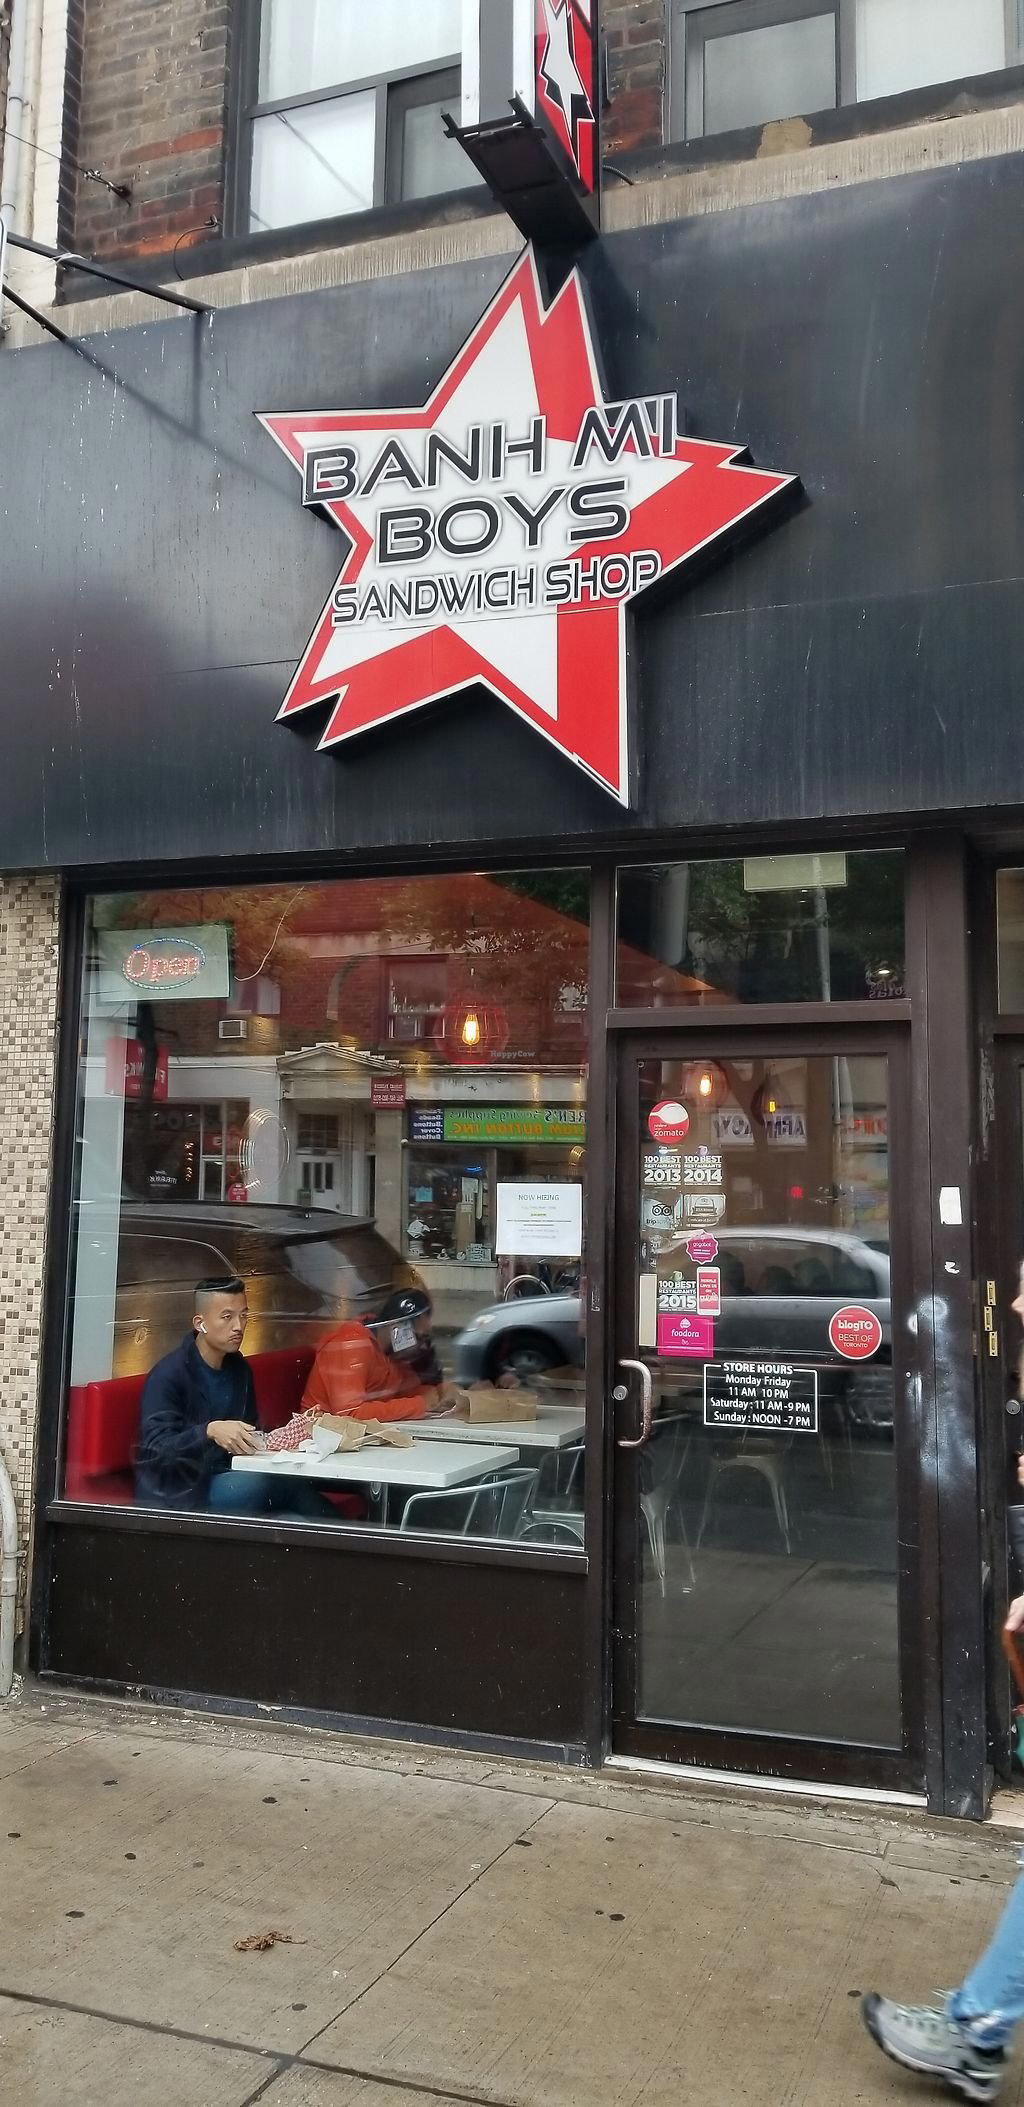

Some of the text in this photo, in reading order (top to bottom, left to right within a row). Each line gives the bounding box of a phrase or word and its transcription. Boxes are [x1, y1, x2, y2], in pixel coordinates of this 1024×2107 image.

[304, 392, 677, 505] BANH MI
[375, 478, 631, 566] BOYS
[332, 549, 664, 627] SANDWICH SHOP
[126, 950, 200, 982] Open
[653, 1129, 684, 1137] zomato
[644, 1155, 682, 1164] 100 BEST
[684, 1155, 723, 1164] 100 BEST
[644, 1168, 682, 1183] 2013
[684, 1168, 723, 1183] 2014
[658, 1280, 697, 1289] 100 BEST
[658, 1295, 697, 1309] 2015
[838, 1319, 873, 1331] blogTO
[671, 1329, 700, 1338] foodora
[838, 1333, 860, 1342] BEST
[723, 1363, 794, 1375] STORE HOURS
[725, 1374, 792, 1388] Monday Friday
[729, 1387, 789, 1399] 11 AM 10 PM
[755, 1400, 765, 1410] 11
[795, 1402, 811, 1412] PM
[752, 1413, 781, 1424] NOON
[795, 1416, 811, 1426] PM
